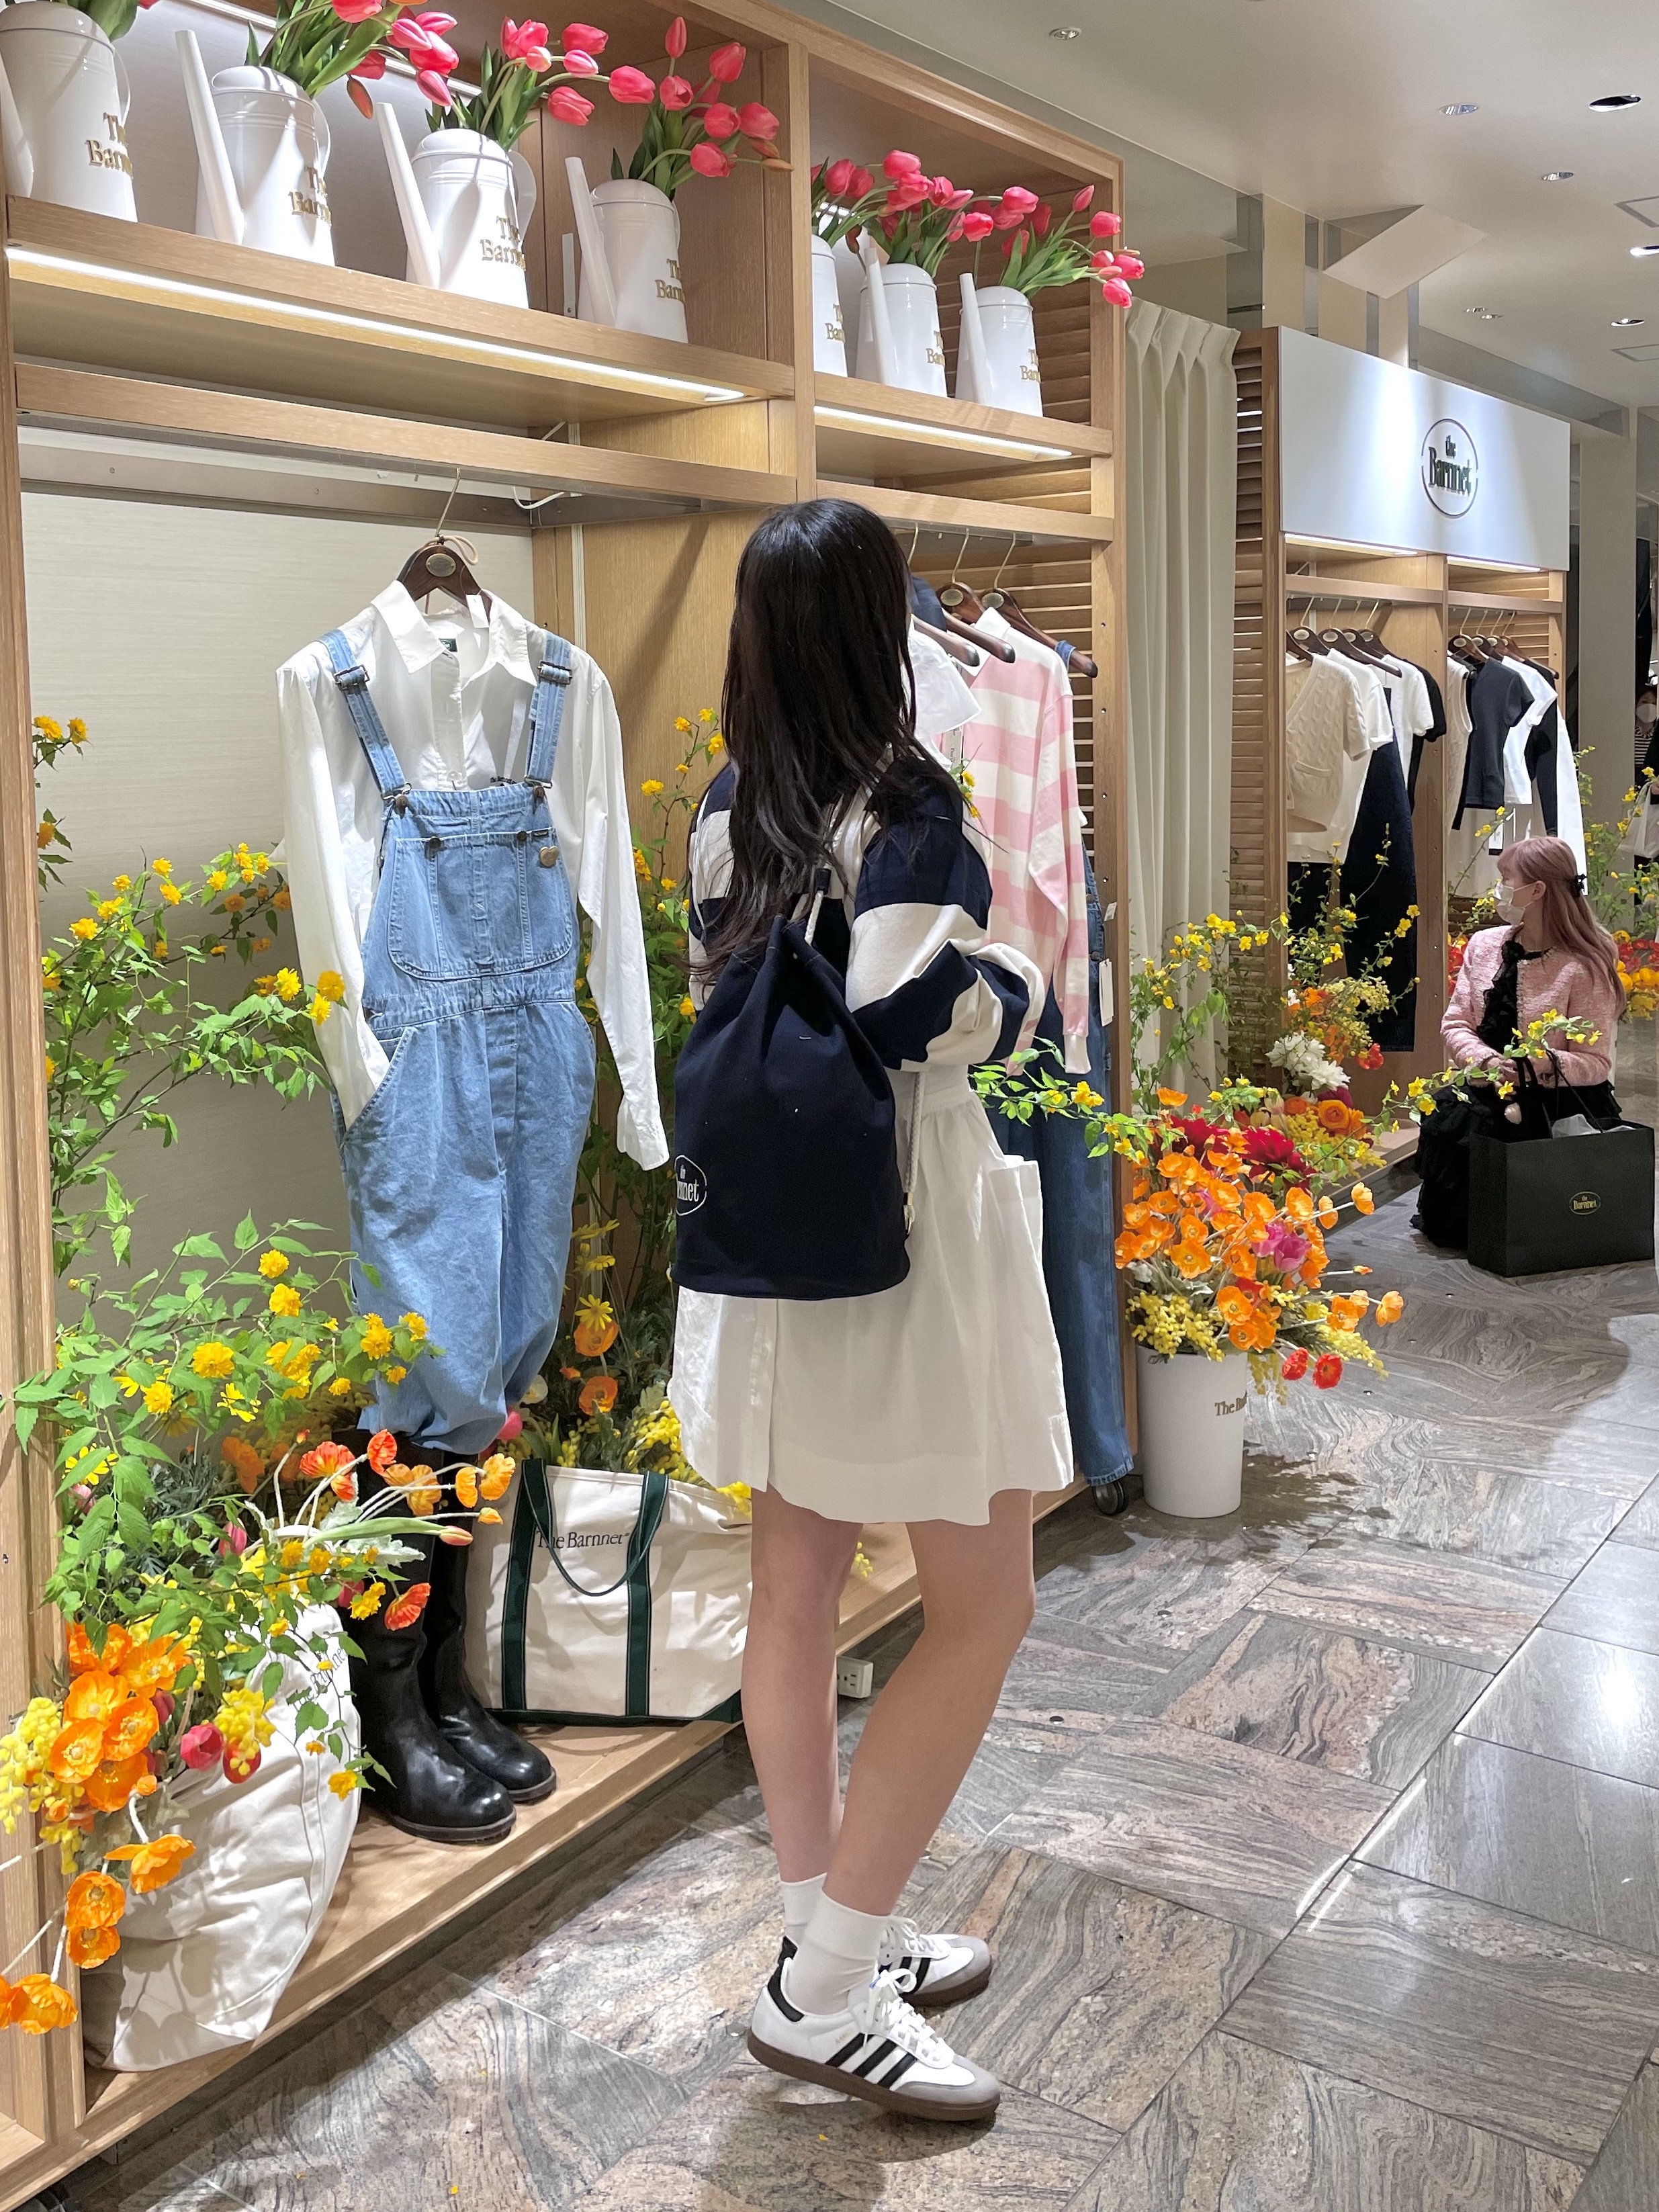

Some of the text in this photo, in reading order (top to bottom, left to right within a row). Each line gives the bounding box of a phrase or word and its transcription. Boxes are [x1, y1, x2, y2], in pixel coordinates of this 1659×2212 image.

[1429, 446, 1472, 497] Barnnet
[1214, 1401, 1235, 1416] The
[567, 1532, 624, 1548] Barnnet
